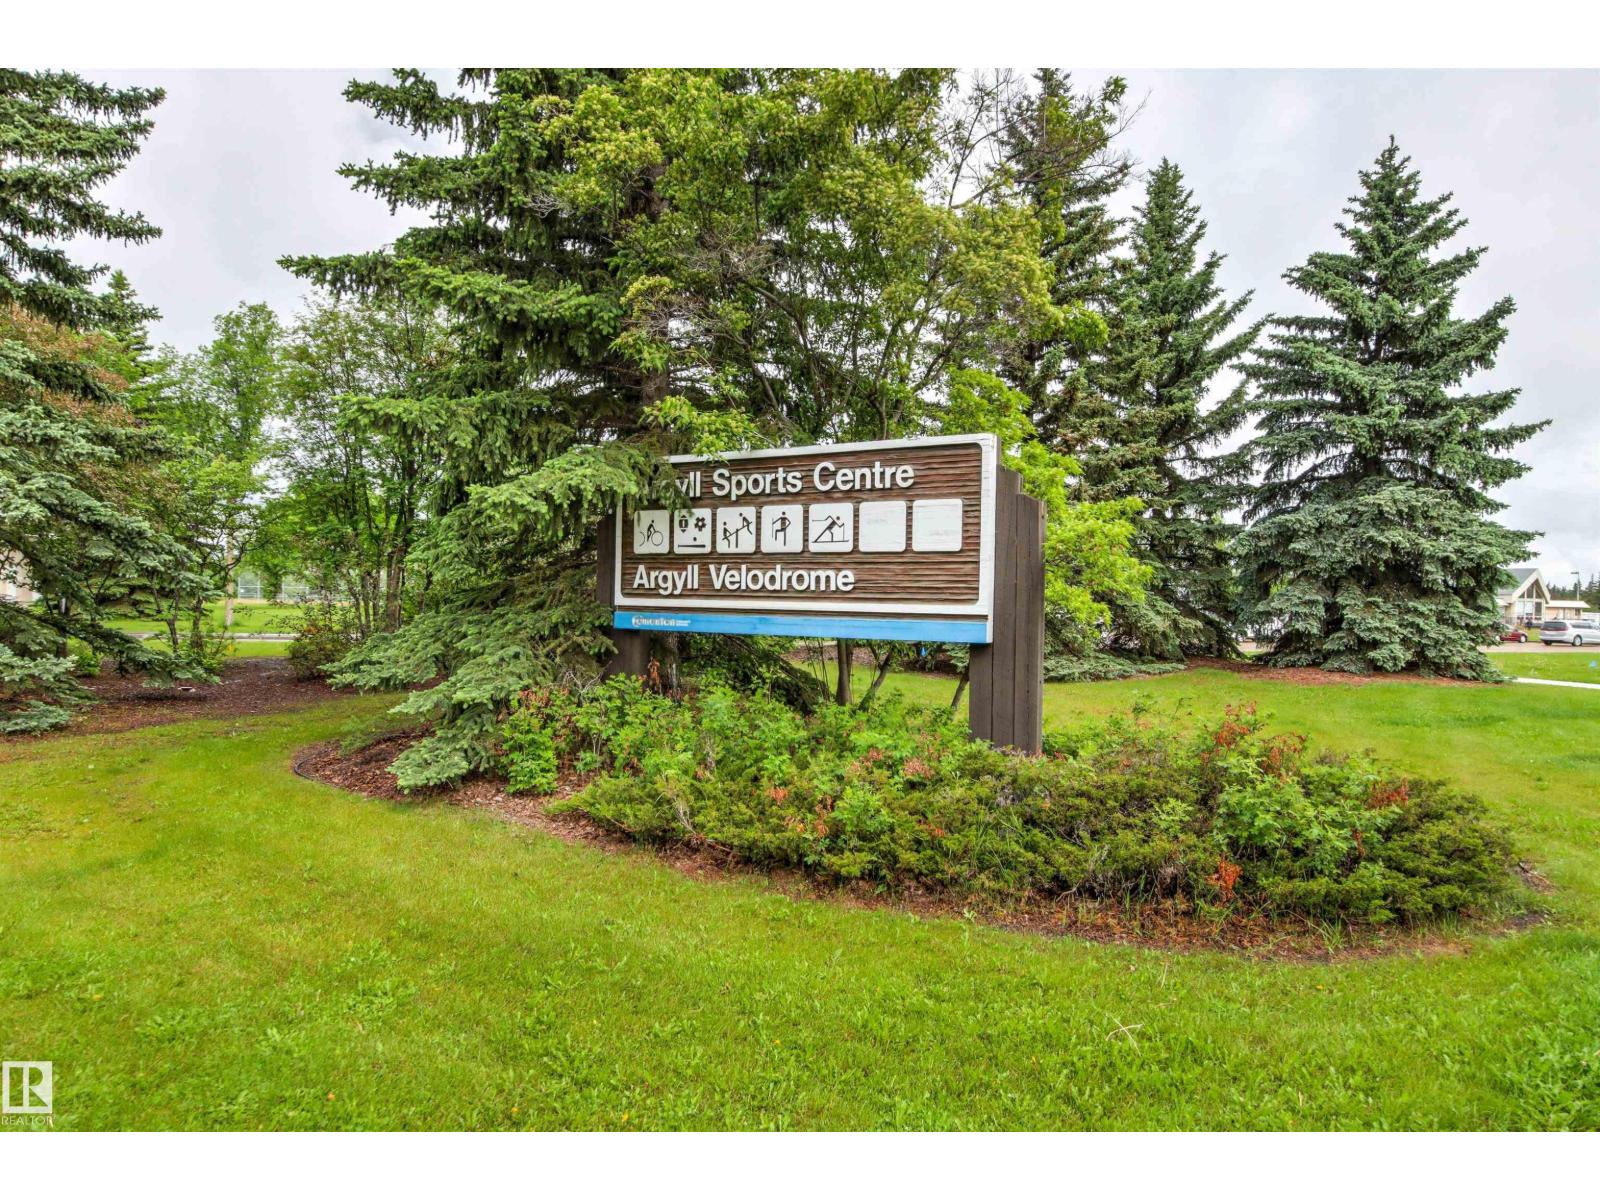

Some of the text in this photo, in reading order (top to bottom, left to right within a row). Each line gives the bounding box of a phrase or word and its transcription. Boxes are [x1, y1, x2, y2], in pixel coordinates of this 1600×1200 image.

[712, 467, 803, 501] Sports
[813, 461, 915, 492] Centre
[632, 564, 855, 596] Argyll Velodrome
